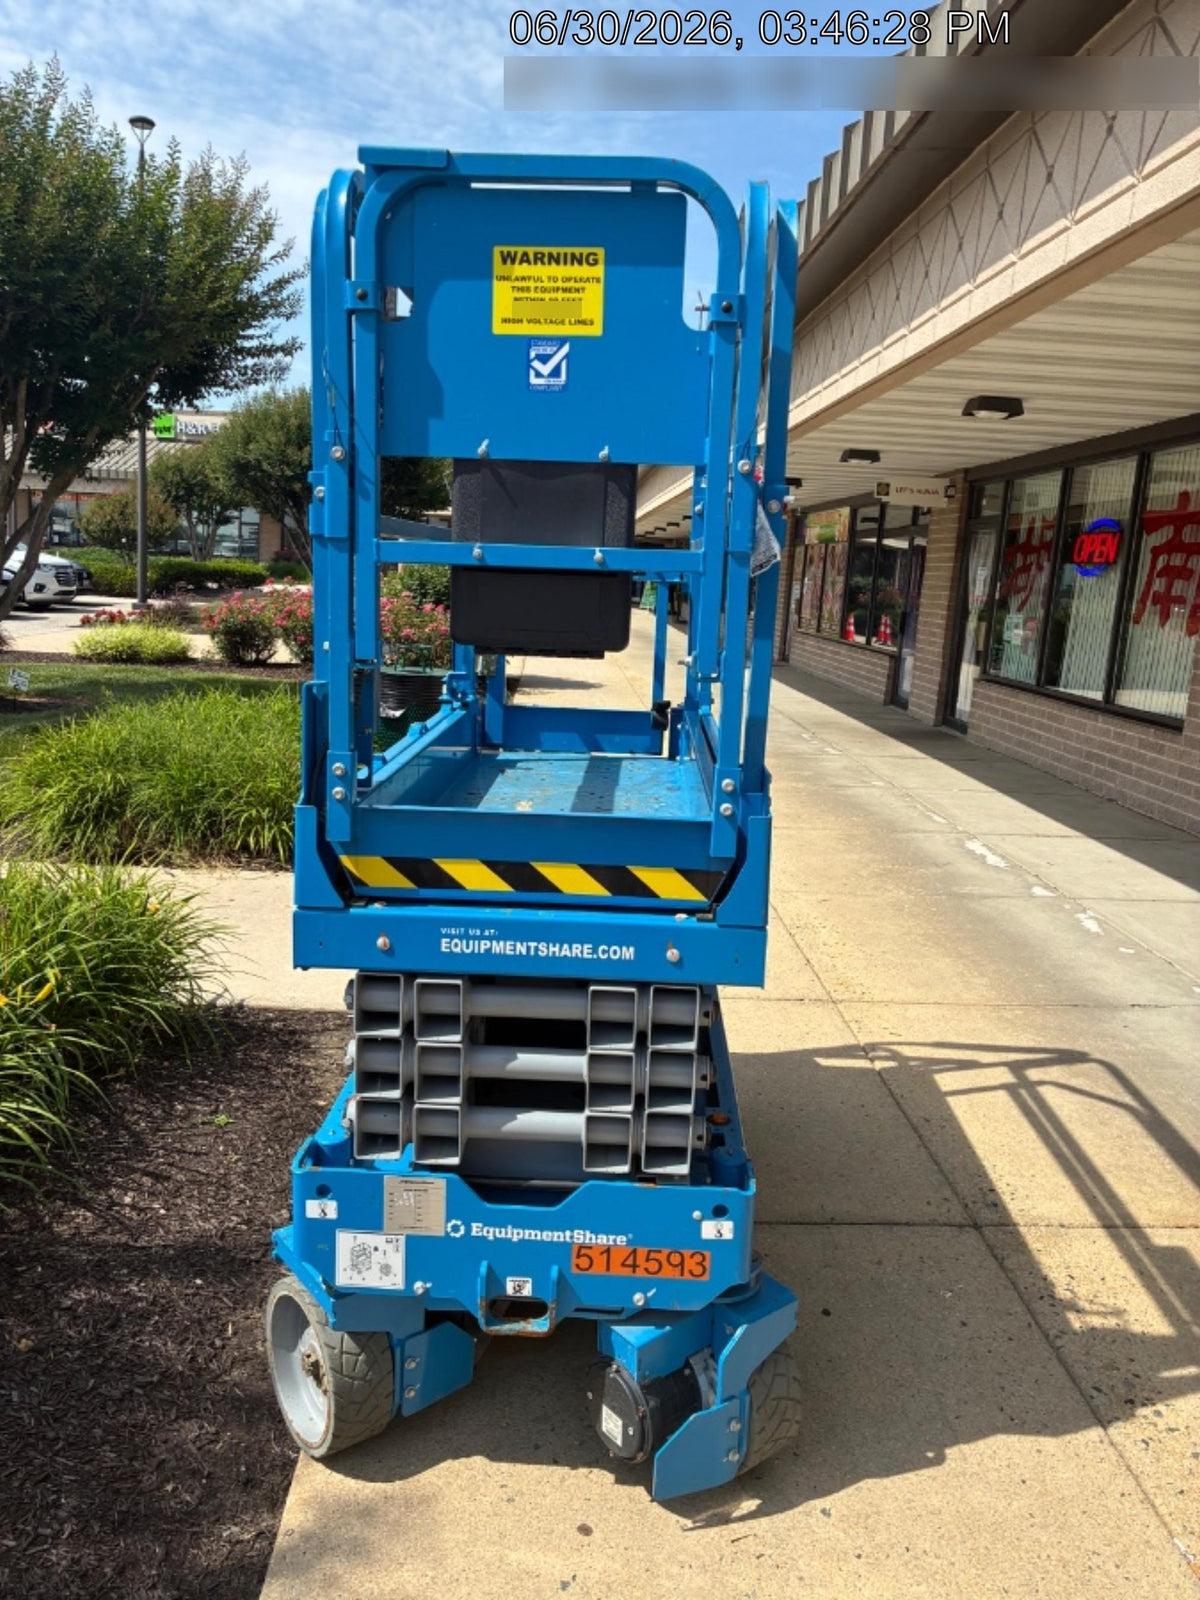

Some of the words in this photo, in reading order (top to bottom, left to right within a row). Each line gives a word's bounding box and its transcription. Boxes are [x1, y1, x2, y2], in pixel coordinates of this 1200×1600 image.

[500, 250, 599, 267] WARNING
[496, 274, 545, 283] UNLAWFUL
[561, 276, 601, 284] OPERATE
[511, 286, 531, 294] THIS
[534, 286, 586, 294] EQUIPMENT
[501, 317, 523, 325] HIGH
[526, 318, 566, 326] VOLTAGE
[1073, 531, 1122, 564] OPEN
[440, 927, 465, 935] VISIT
[468, 928, 481, 936] US
[440, 938, 635, 960] EQUIPMENTSHARE.COM
[575, 1245, 707, 1278] 514593
